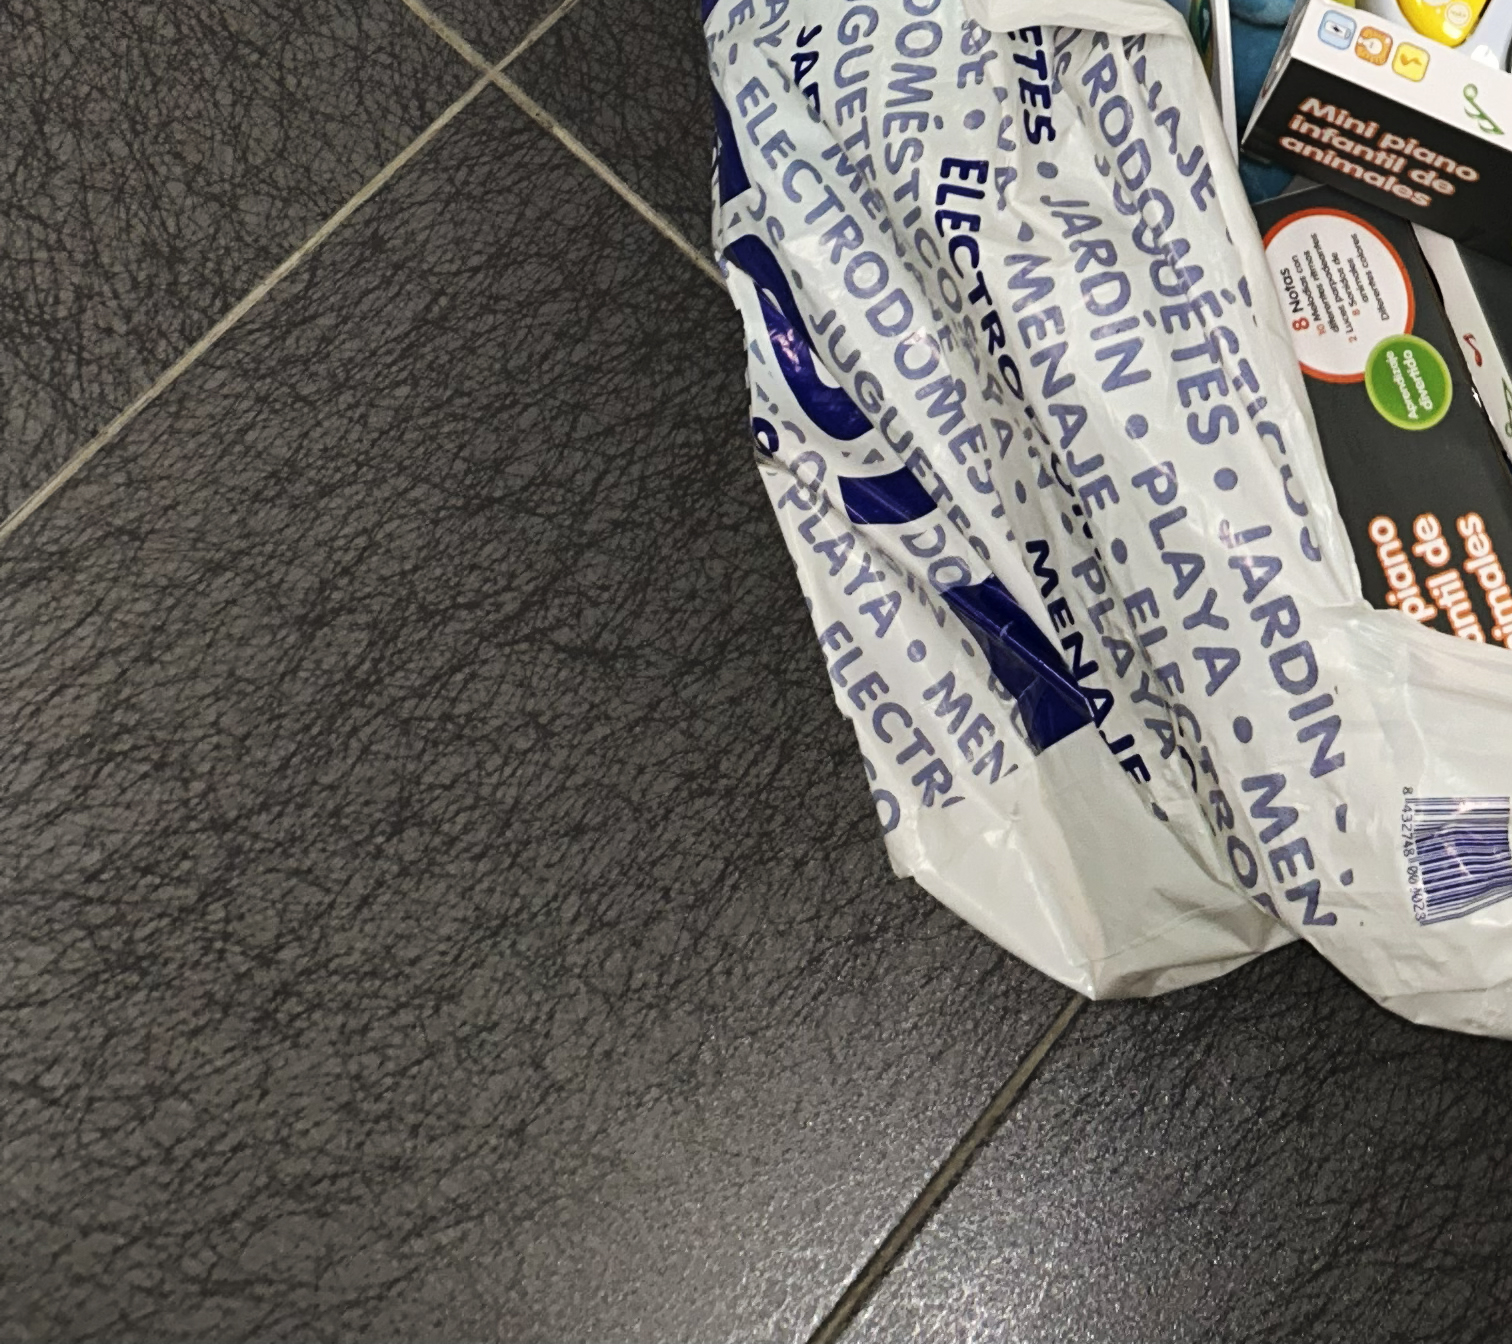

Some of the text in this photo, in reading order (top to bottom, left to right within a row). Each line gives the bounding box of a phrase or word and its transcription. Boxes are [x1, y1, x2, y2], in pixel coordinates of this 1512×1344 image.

[1279, 135, 1433, 208] animales
[1288, 114, 1456, 197] infantil de
[1298, 96, 1480, 183] Mini piano
[1039, 193, 1158, 392] JARDÍN
[1280, 267, 1310, 332] 8 Notas
[1003, 252, 1121, 515] MENAJE
[1385, 349, 1419, 420] Aprendizaje
[1402, 349, 1433, 412] divertido
[1130, 459, 1243, 699] PLAYA
[1412, 511, 1451, 569] de
[1025, 537, 1153, 785] MENAJE
